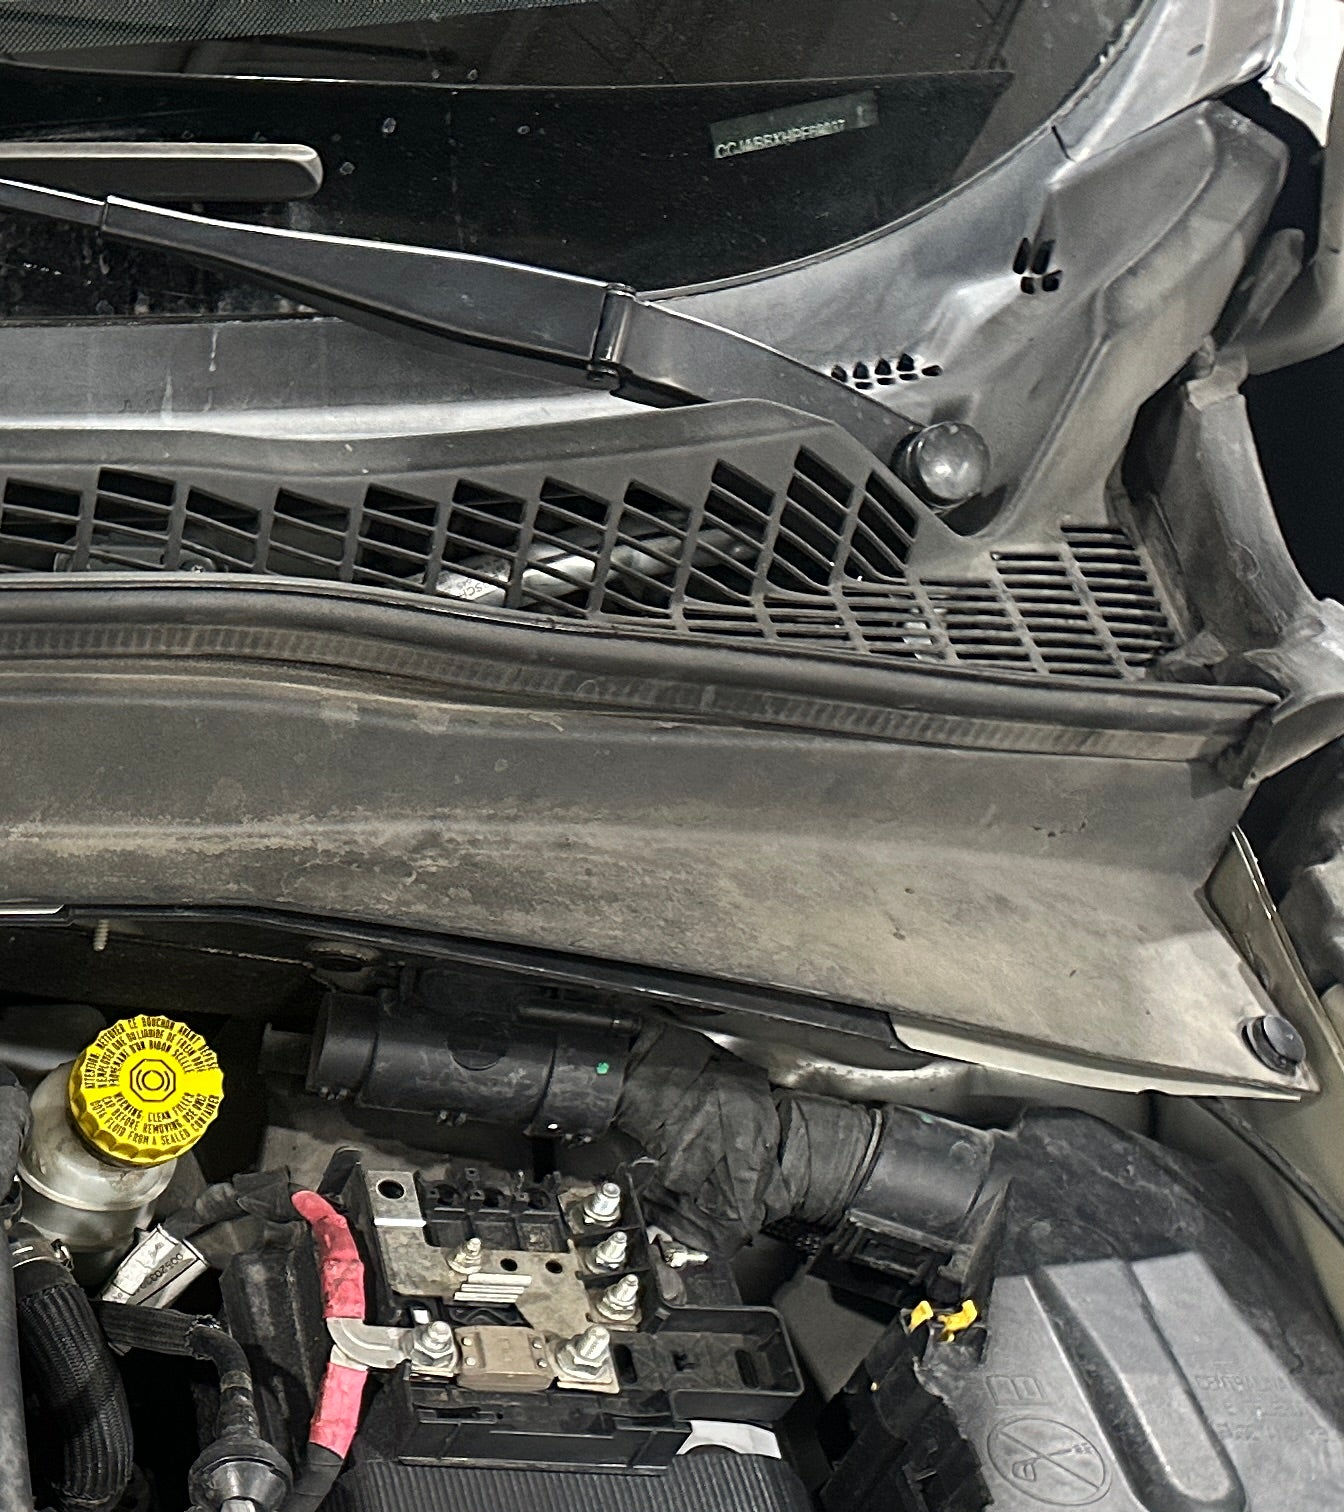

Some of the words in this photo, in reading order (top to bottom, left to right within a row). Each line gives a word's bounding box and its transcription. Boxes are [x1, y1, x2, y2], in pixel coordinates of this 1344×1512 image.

[177, 1026, 201, 1044] AVANT
[112, 1108, 140, 1131] BEFORE
[148, 1110, 171, 1122] CLEAN
[104, 1117, 126, 1137] FLUID
[128, 1131, 149, 1145] FROM
[161, 1129, 191, 1146] SEALED
